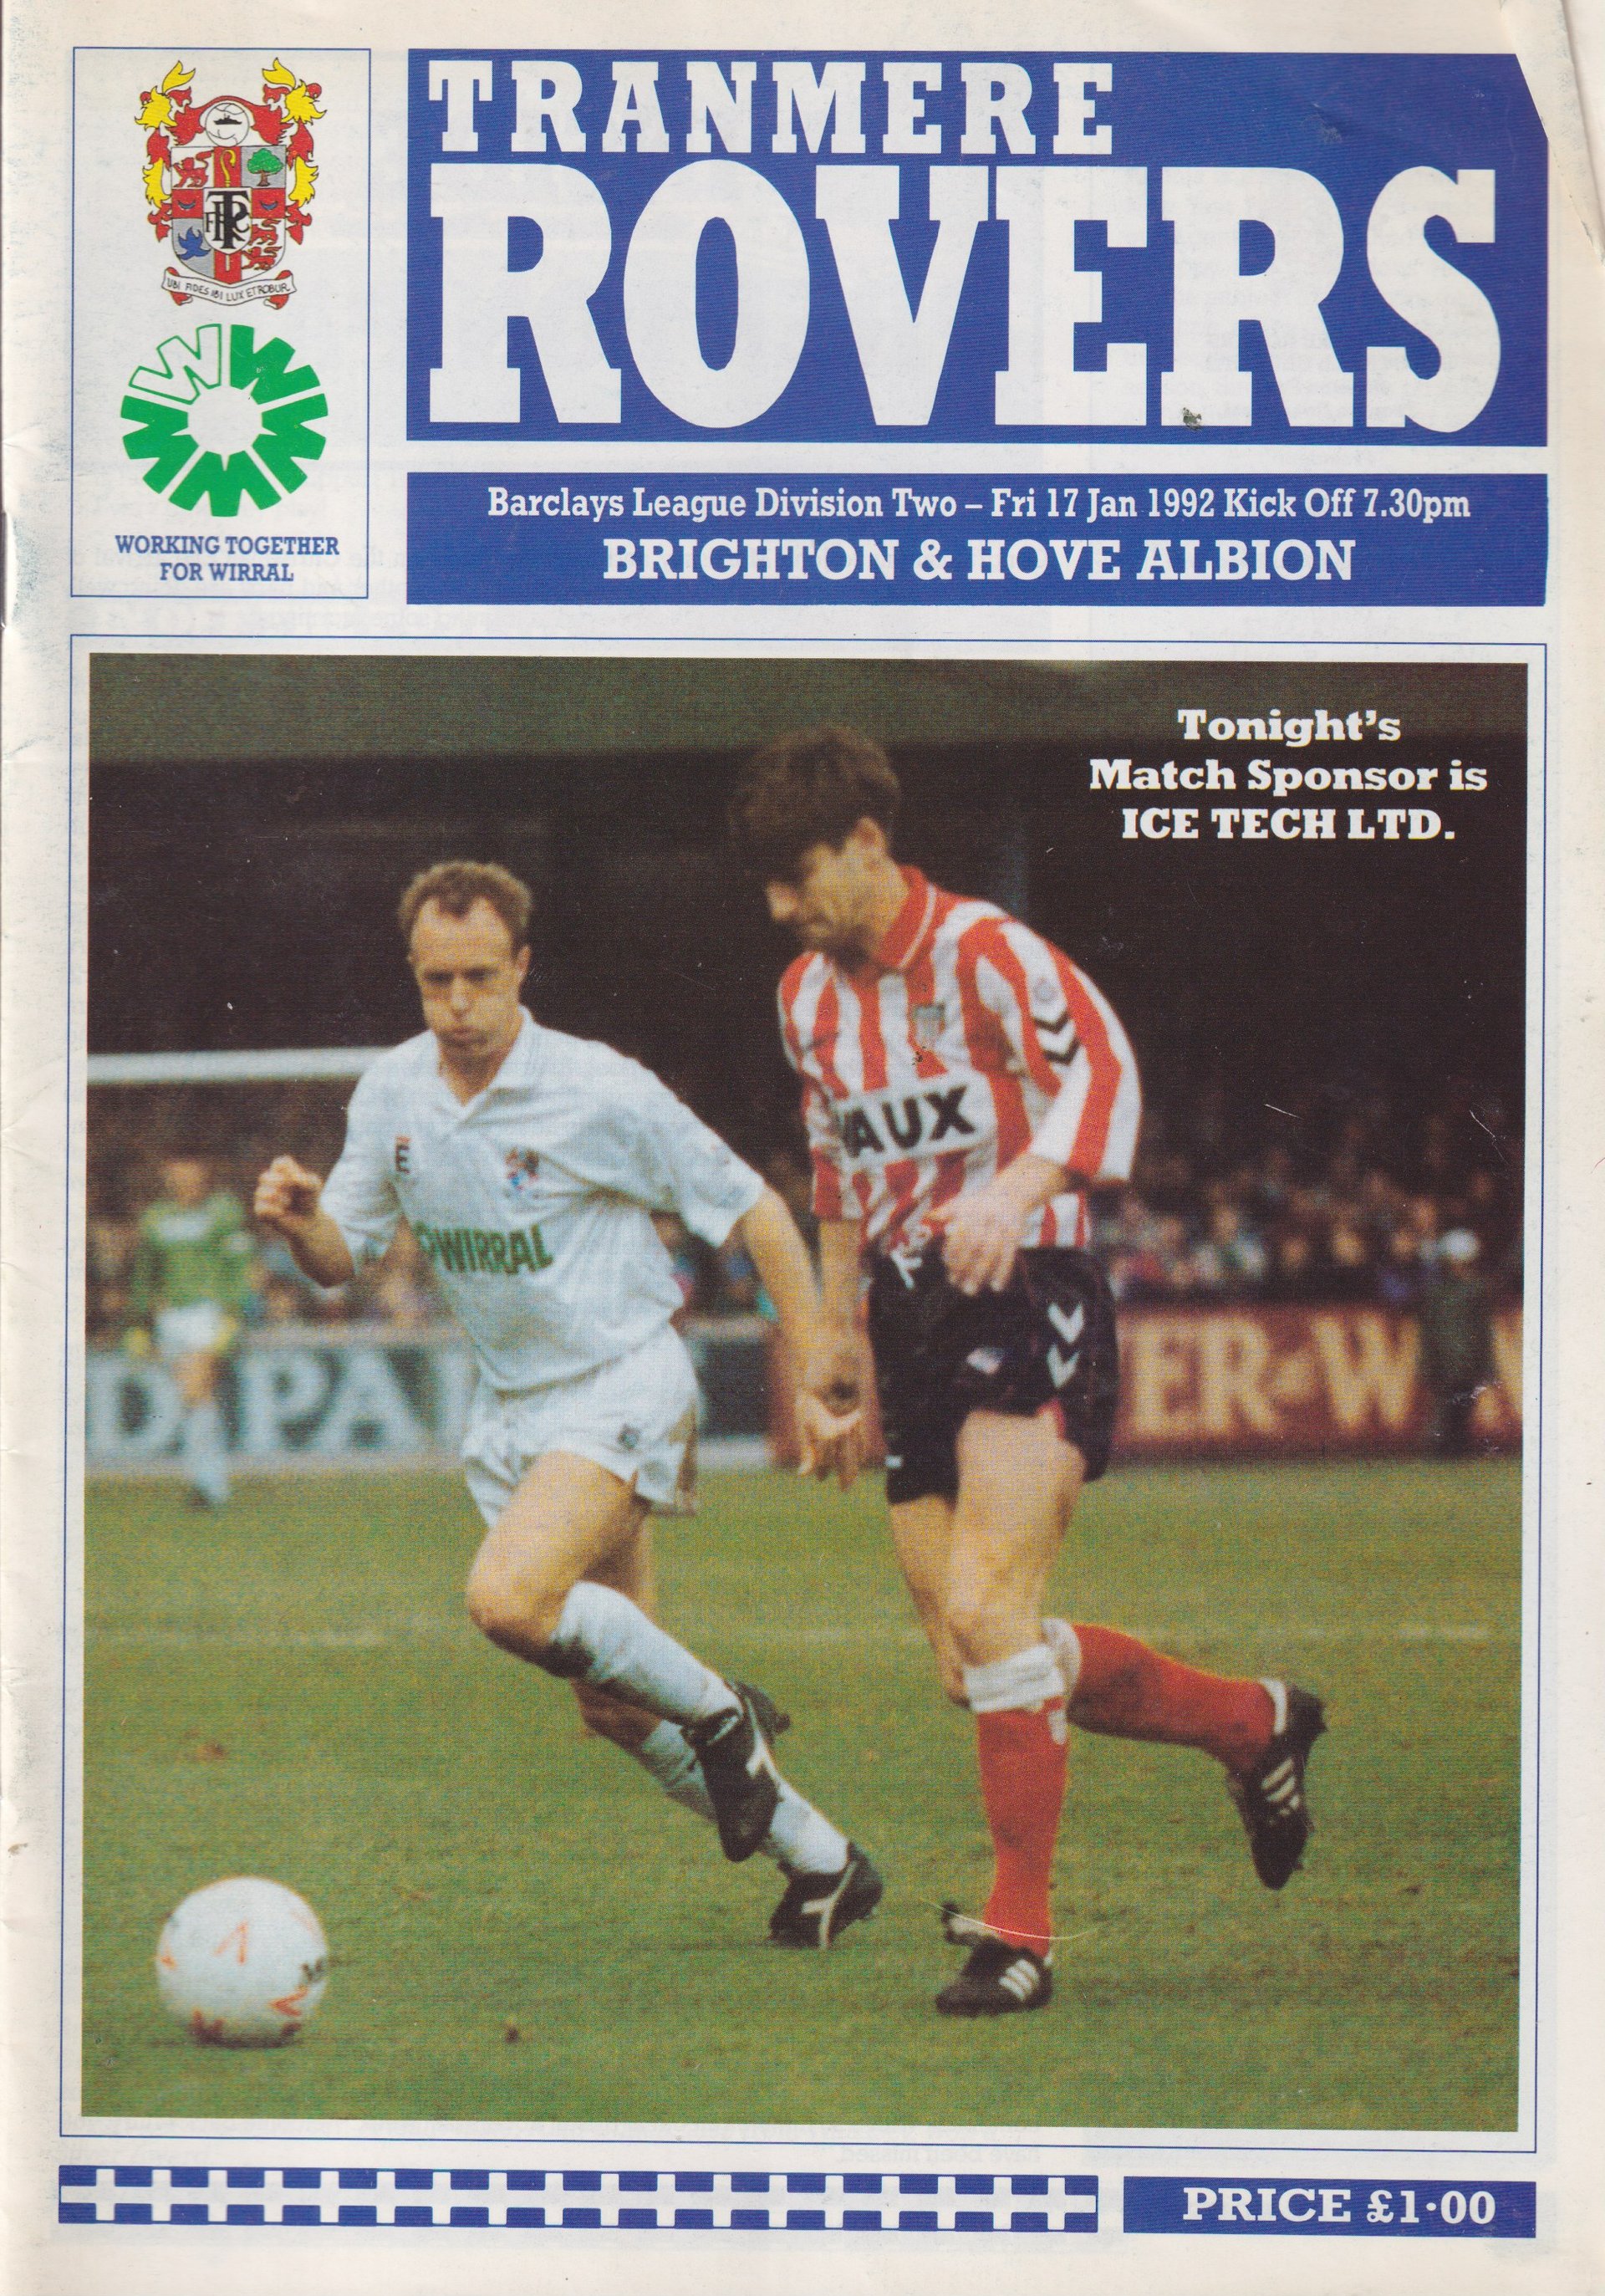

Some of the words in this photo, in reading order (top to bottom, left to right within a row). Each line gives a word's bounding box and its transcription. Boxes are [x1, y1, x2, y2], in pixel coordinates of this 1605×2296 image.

[429, 60, 1113, 156] TRANMERE
[185, 282, 209, 295] FIDES
[430, 160, 1501, 434] ROVERS
[488, 486, 624, 523] Barclays
[633, 487, 746, 523] League
[755, 487, 884, 518] Division
[892, 487, 958, 518] Two
[991, 487, 1037, 518] Fri
[1047, 487, 1079, 518] 17
[1087, 487, 1138, 523] Jan
[1148, 487, 1215, 518] 1992
[1224, 487, 1297, 518] Kick
[1304, 487, 1358, 518] Off
[1363, 487, 1471, 525] 7.30pm
[115, 534, 220, 555] WORKING
[225, 536, 340, 556] TOGETHER
[604, 538, 899, 580] BRIGHTON
[914, 538, 954, 580] &
[967, 538, 1122, 581] HOVE
[1136, 538, 1357, 581] ALBION
[160, 562, 203, 581] FOR
[209, 563, 294, 582] WIRRAL
[1177, 709, 1402, 747] Tonight's
[1089, 758, 1237, 791] Match
[1248, 758, 1439, 797] Sponsor
[1450, 759, 1488, 792] is
[1122, 807, 1200, 839] ICE
[1210, 808, 1337, 839] TECH
[1348, 809, 1455, 840] LTD.
[1183, 2186, 1352, 2222] PRICE
